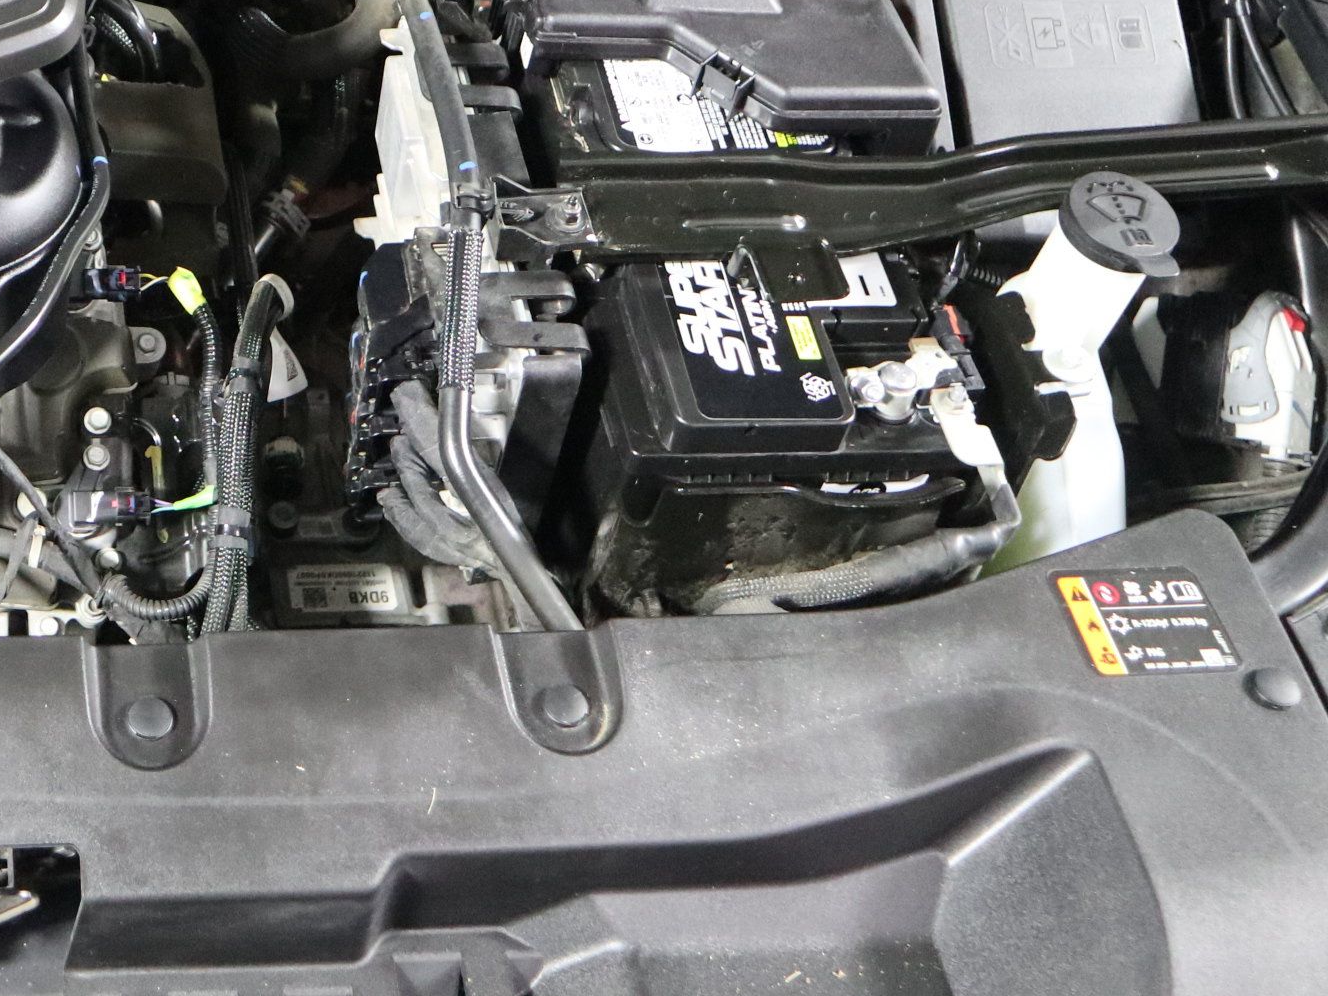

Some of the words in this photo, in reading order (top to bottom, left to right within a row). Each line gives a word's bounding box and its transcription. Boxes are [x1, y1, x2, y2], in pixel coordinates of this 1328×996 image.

[664, 260, 706, 354] SUPE
[690, 260, 756, 377] STAR
[736, 283, 782, 372] PLATIN
